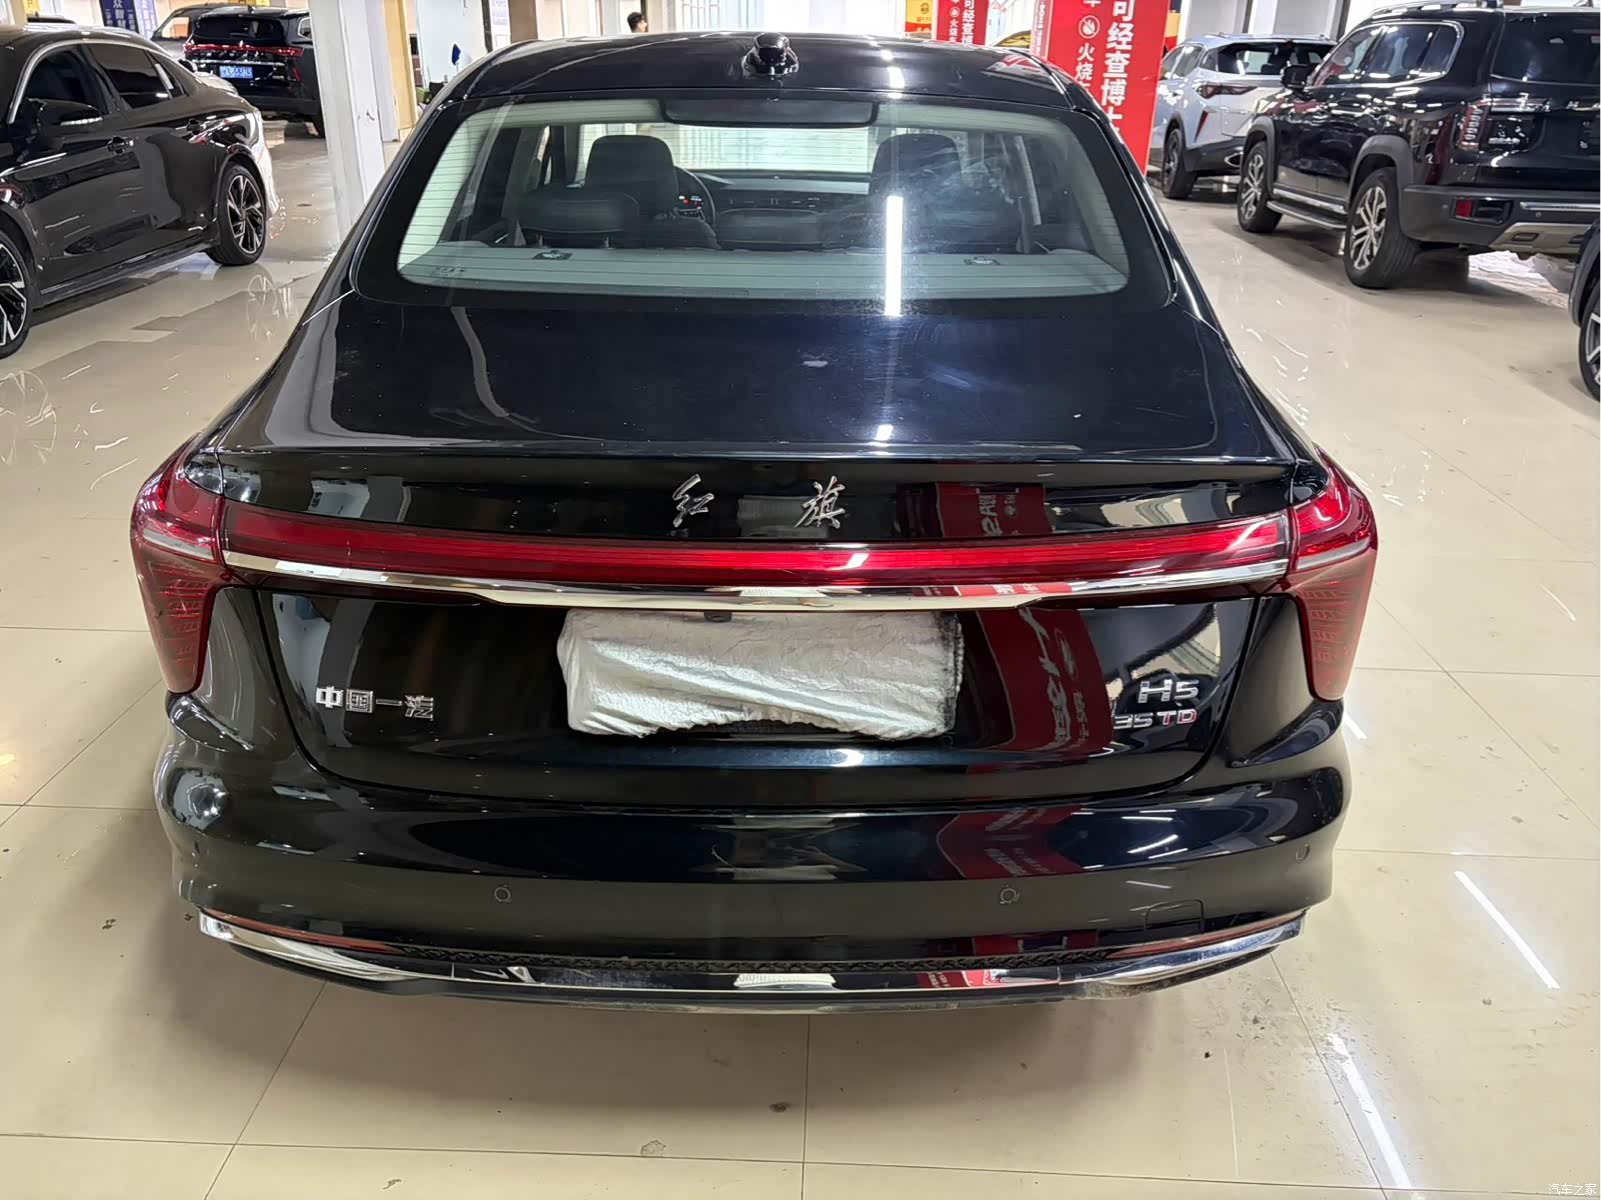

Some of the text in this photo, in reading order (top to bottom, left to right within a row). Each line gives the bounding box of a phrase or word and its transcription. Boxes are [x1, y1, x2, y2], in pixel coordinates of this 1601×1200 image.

[1138, 679, 1199, 703] H5
[316, 686, 434, 721] 中国一汽
[1112, 709, 1197, 729] 35TD
